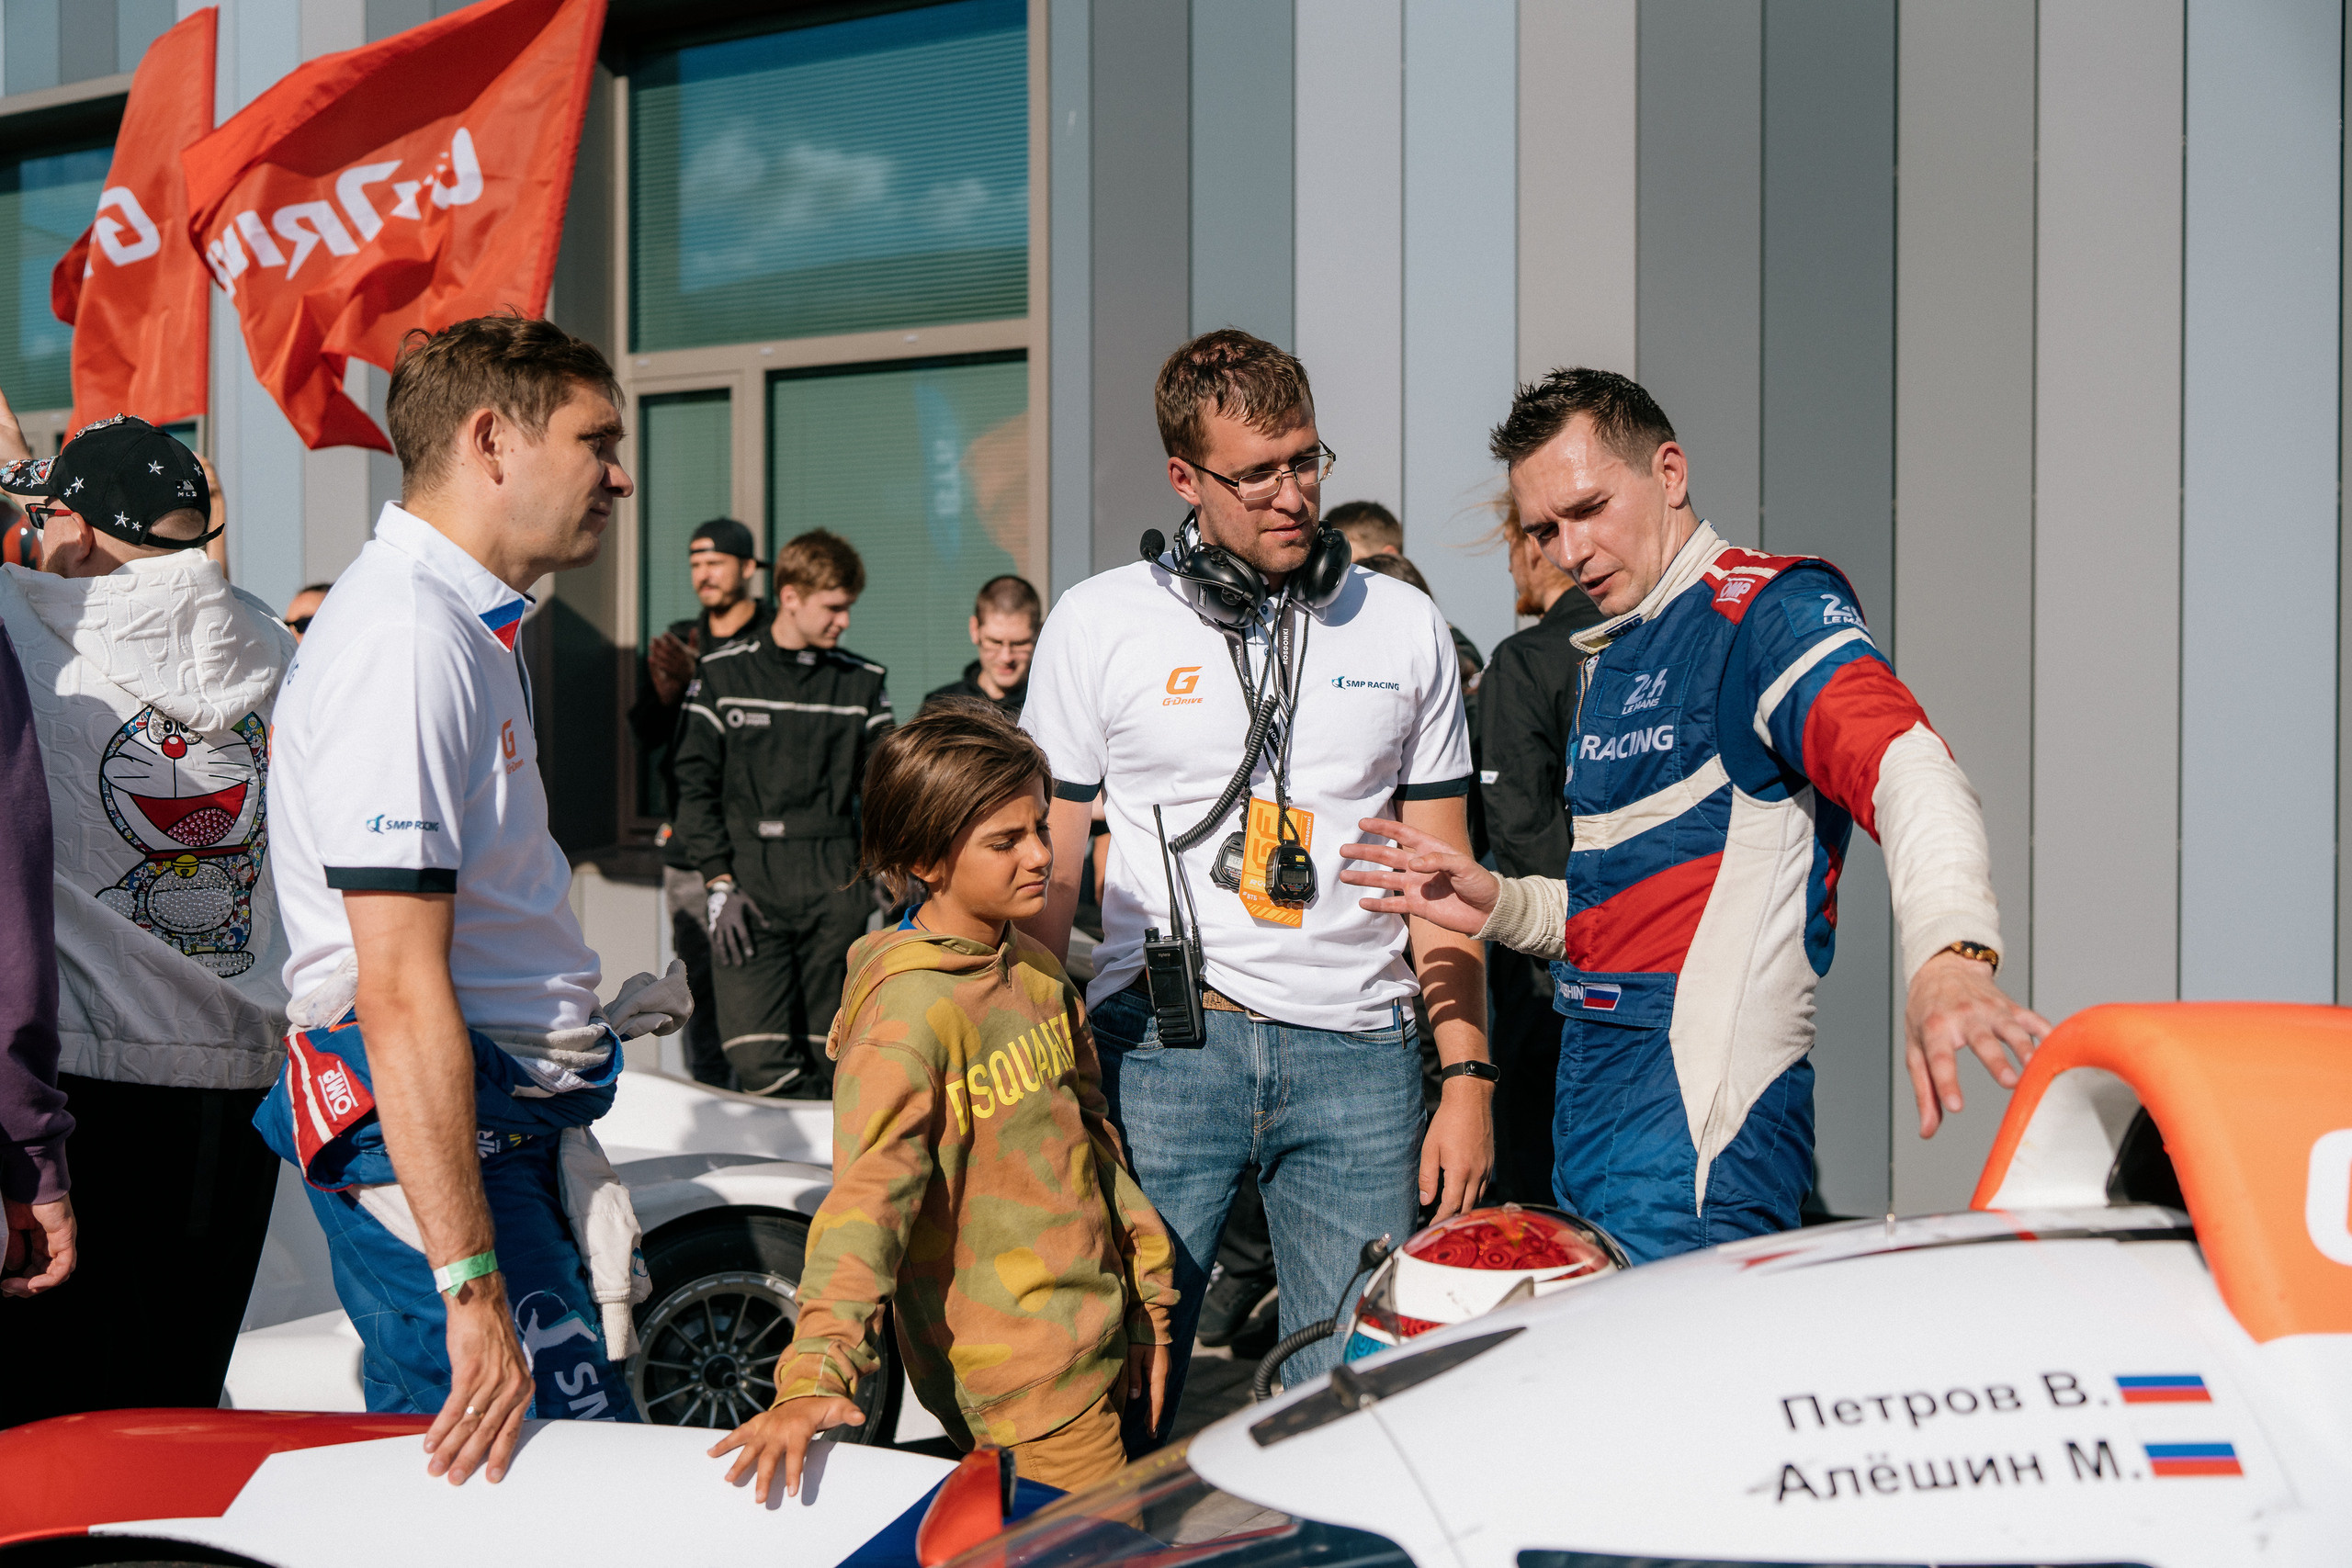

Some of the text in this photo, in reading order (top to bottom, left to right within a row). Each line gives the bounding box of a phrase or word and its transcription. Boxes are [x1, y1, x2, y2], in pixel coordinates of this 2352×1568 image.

[1720, 581, 1752, 598] OMP
[1824, 615, 1842, 625] LE
[1346, 680, 1399, 691] SMP RACING
[1621, 698, 1660, 715] LE MANS
[1579, 725, 1674, 761] RACING
[386, 820, 413, 830] SMP
[322, 1069, 352, 1115] OMP
[1781, 1371, 2110, 1432] Петров В.
[1775, 1438, 2143, 1504] Алёшин М.
